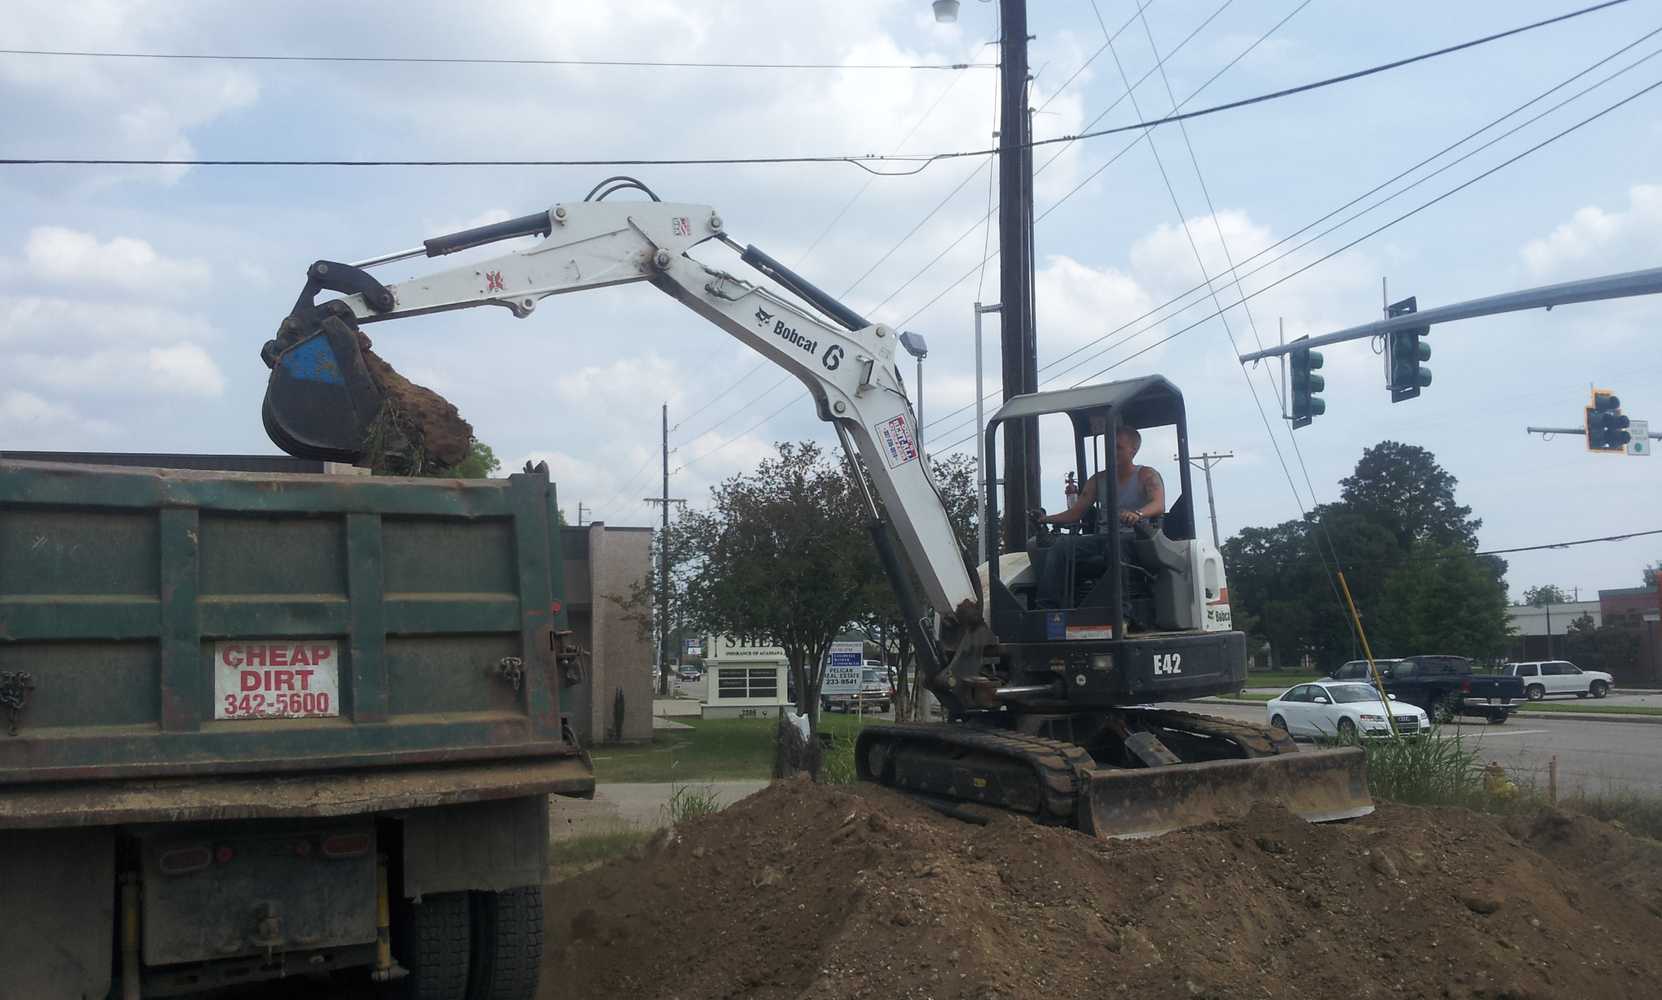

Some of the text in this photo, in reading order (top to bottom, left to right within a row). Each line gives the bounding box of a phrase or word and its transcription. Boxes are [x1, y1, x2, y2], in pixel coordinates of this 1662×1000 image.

[773, 320, 818, 354] Bobcat
[1215, 610, 1230, 622] Bobca
[223, 645, 331, 667] CHEAP
[1153, 653, 1182, 675] E42
[240, 670, 314, 691] DIRT
[224, 692, 330, 714] 342-5600
